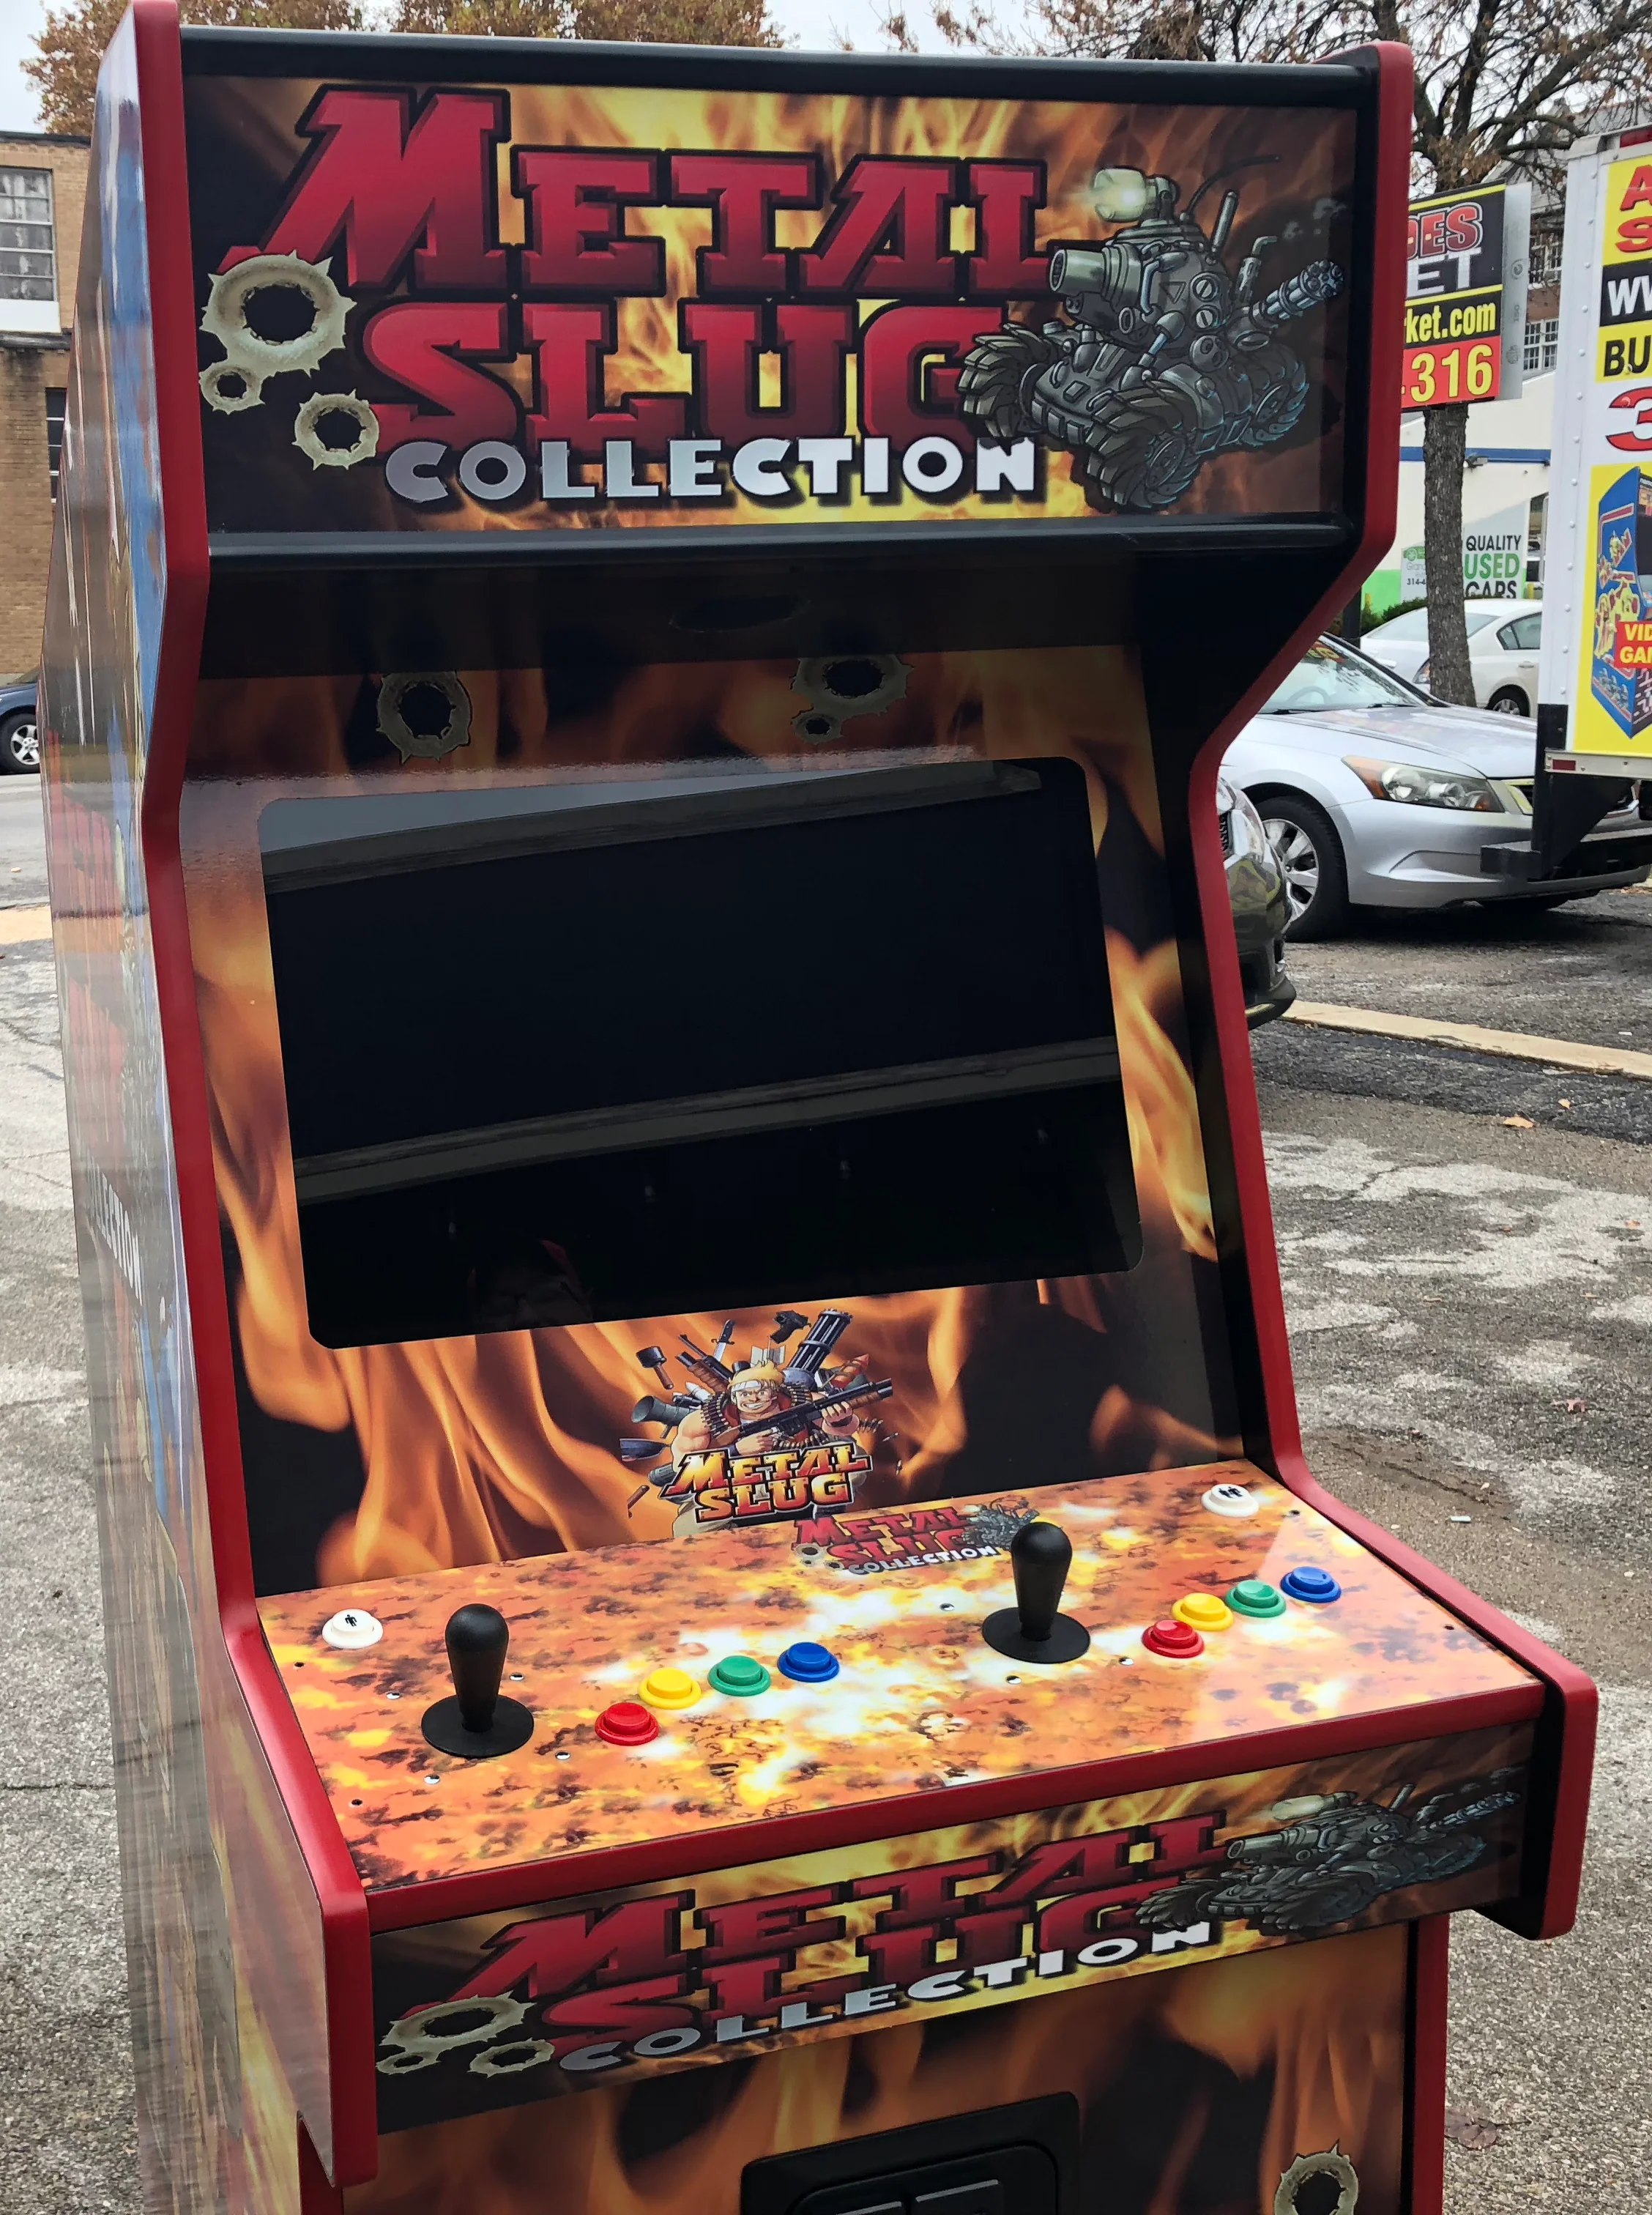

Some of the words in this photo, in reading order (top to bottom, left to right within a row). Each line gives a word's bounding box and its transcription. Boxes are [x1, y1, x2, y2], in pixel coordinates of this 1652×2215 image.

[218, 84, 1053, 289] METAL
[1404, 302, 1496, 344] ket.com
[365, 301, 1008, 450] SLUG
[385, 437, 1035, 503] COLLECTION
[1465, 553, 1520, 579] USED
[1466, 535, 1522, 552] QUALITY
[1466, 581, 1517, 598] CARS
[662, 1444, 870, 1496] METAL
[697, 1472, 849, 1521] SLUG
[792, 1507, 970, 1550] METAL
[827, 1528, 965, 1569] SLUG
[848, 1545, 997, 1574] COLLECTION
[400, 1811, 1227, 2019] METAL
[541, 1877, 1169, 2055] SLUG
[559, 1921, 1210, 2071] COLLECTION
